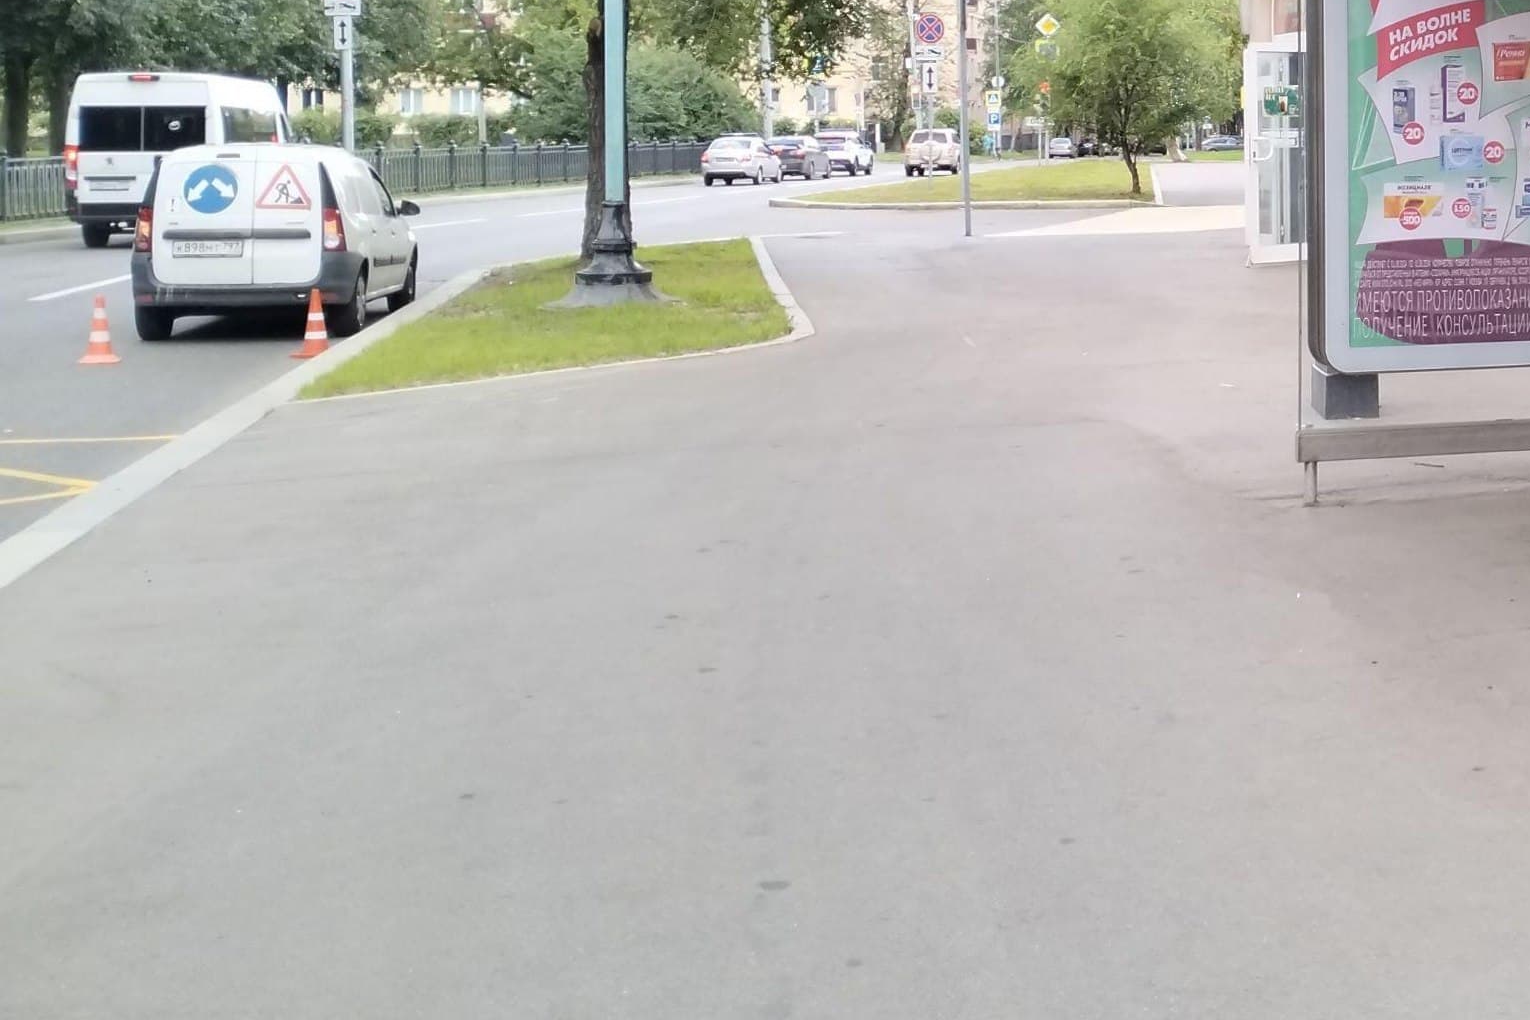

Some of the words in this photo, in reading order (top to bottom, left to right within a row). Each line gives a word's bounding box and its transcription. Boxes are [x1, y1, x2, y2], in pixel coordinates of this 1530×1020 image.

[1389, 25, 1413, 46] НА
[1417, 8, 1472, 32] ВОЛНЕ
[1389, 28, 1459, 61] СКИДОК
[1354, 290, 1413, 313] ИМЕЮТСЯ
[1353, 315, 1428, 339] ПОЛУЧЕНИЕ
